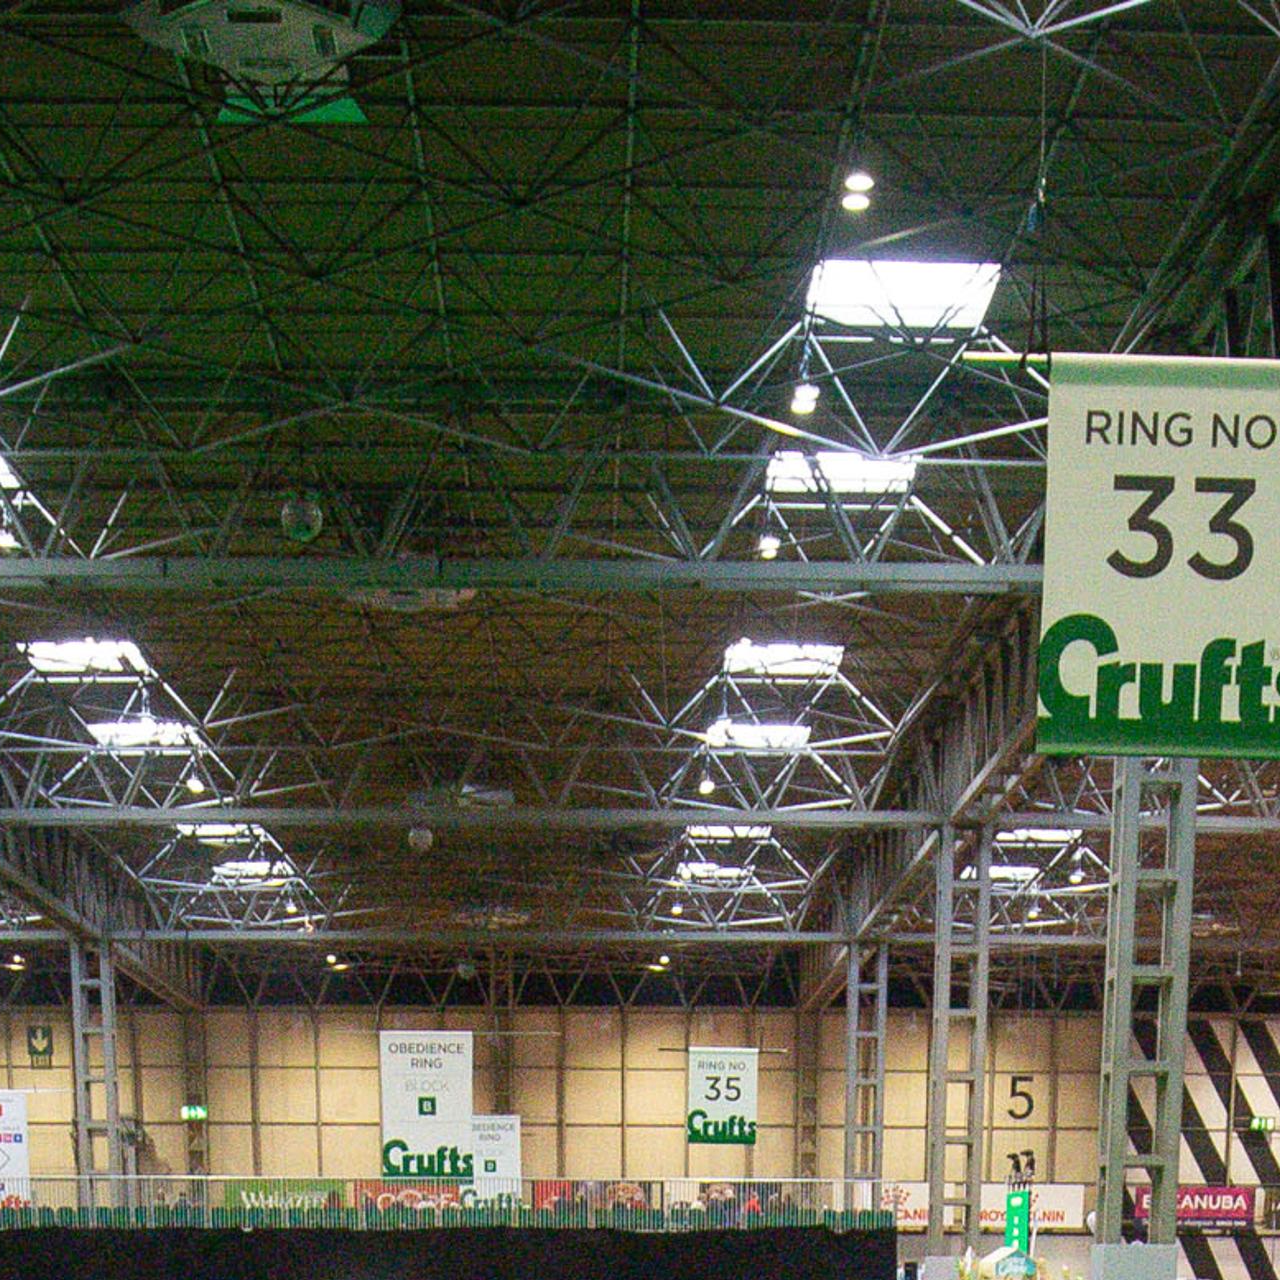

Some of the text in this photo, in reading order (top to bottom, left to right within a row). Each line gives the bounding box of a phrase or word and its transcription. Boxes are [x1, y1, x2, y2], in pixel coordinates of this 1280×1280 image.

[1085, 409, 1193, 448] RING
[1106, 474, 1257, 581] 33
[388, 1042, 465, 1054] OBEDIENCE
[410, 1058, 443, 1069] RING
[698, 1061, 725, 1071] RING
[704, 1075, 742, 1101] 35
[1006, 1076, 1034, 1120] 5
[688, 1109, 756, 1137] Crufts
[383, 1138, 474, 1175] Crufts
